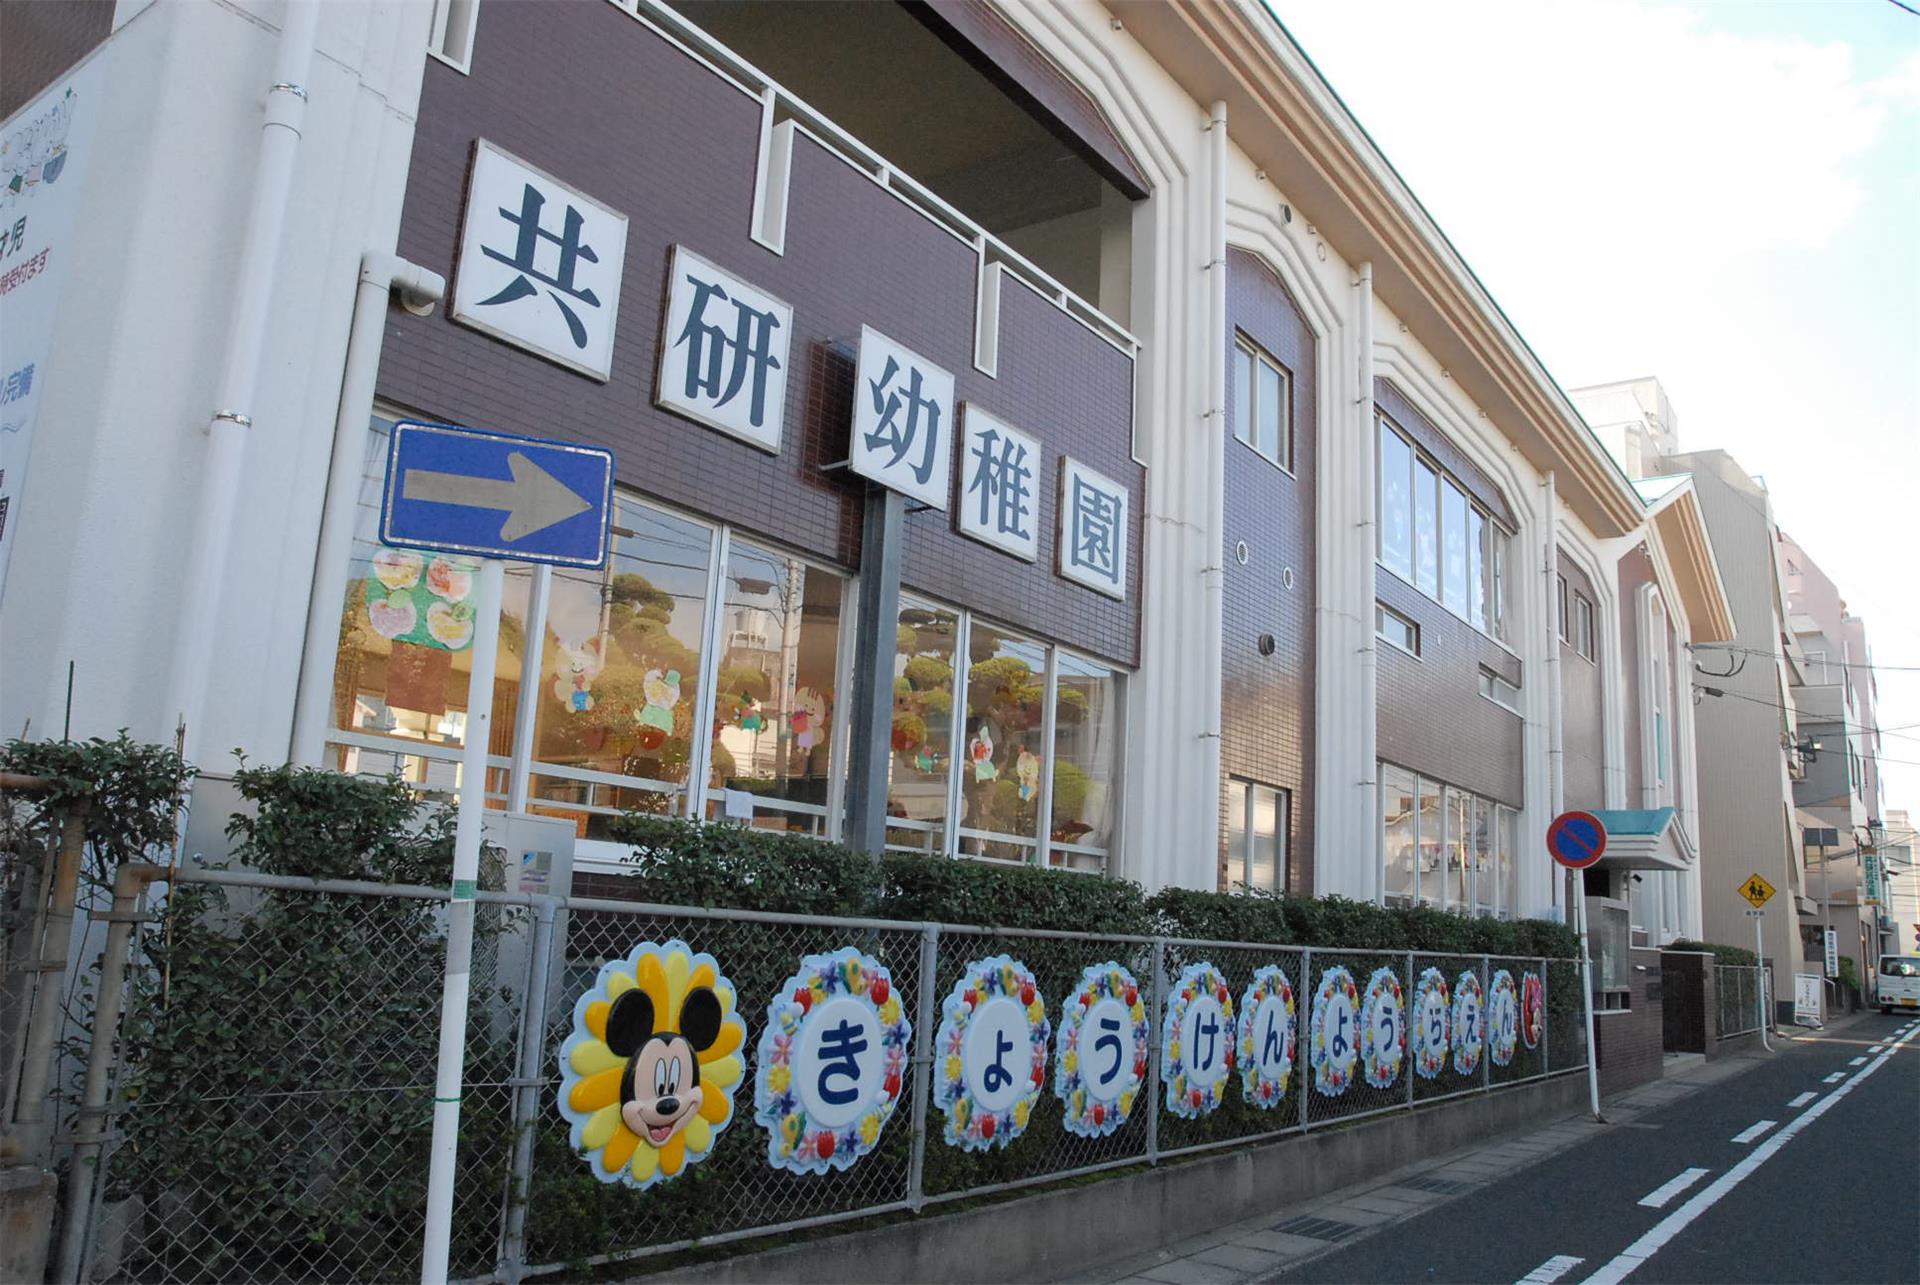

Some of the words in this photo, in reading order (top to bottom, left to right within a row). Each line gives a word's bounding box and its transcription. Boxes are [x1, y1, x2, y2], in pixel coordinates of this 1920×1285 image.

[475, 183, 1122, 585] 共研幼稚園
